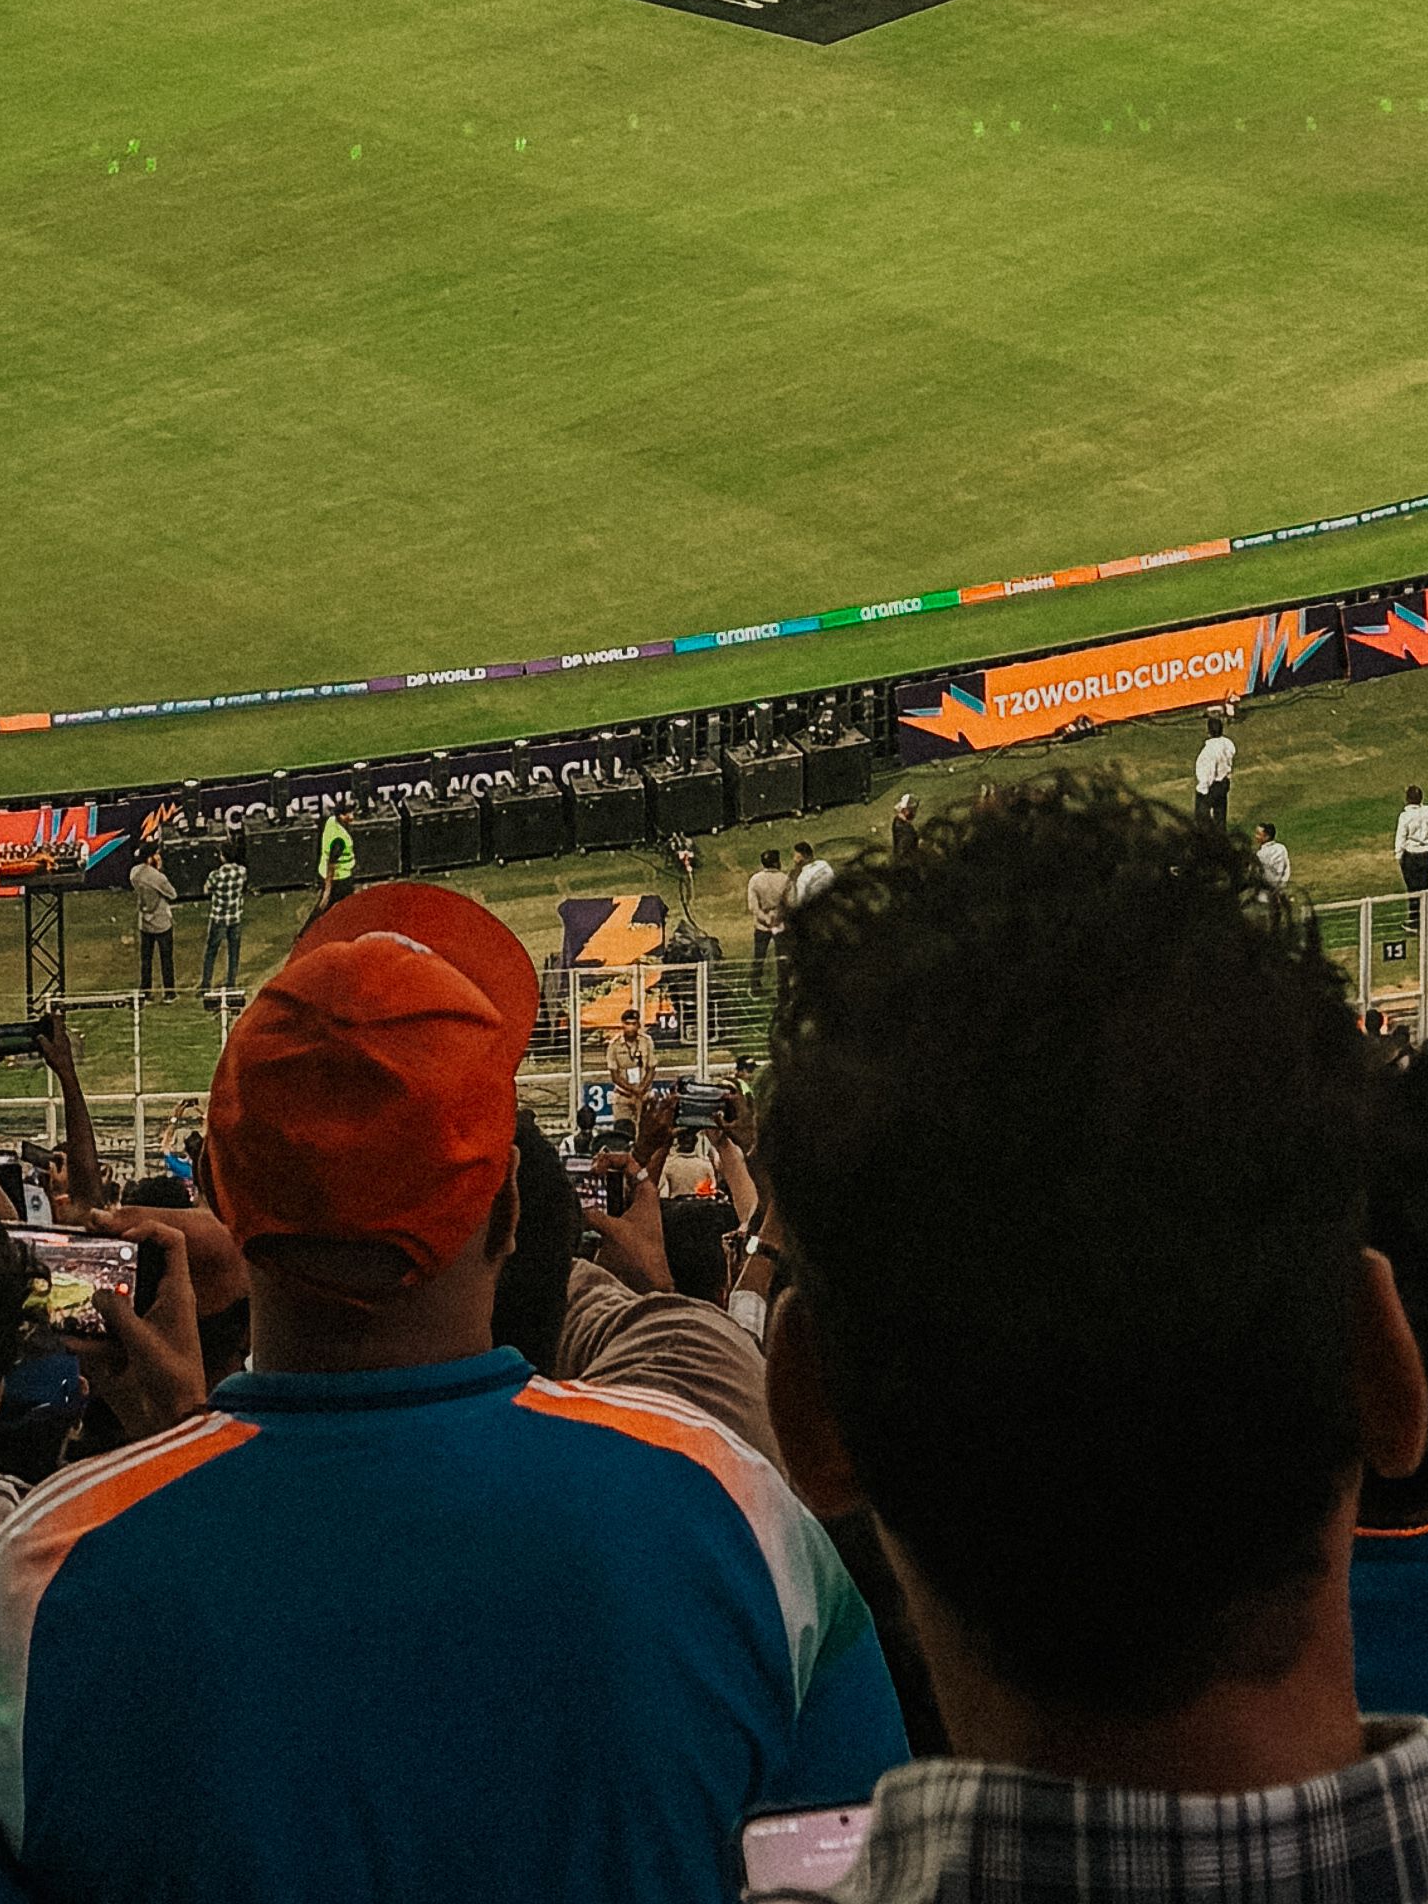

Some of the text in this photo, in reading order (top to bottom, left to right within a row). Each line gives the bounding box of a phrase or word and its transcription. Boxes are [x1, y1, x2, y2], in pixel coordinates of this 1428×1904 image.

[860, 597, 923, 622] aramco
[584, 647, 639, 665] WORLD
[429, 667, 486, 685] WORLD
[994, 646, 1245, 718] T20WORLDCUP.COM
[658, 1015, 678, 1029] 16
[588, 1085, 605, 1111] 3
